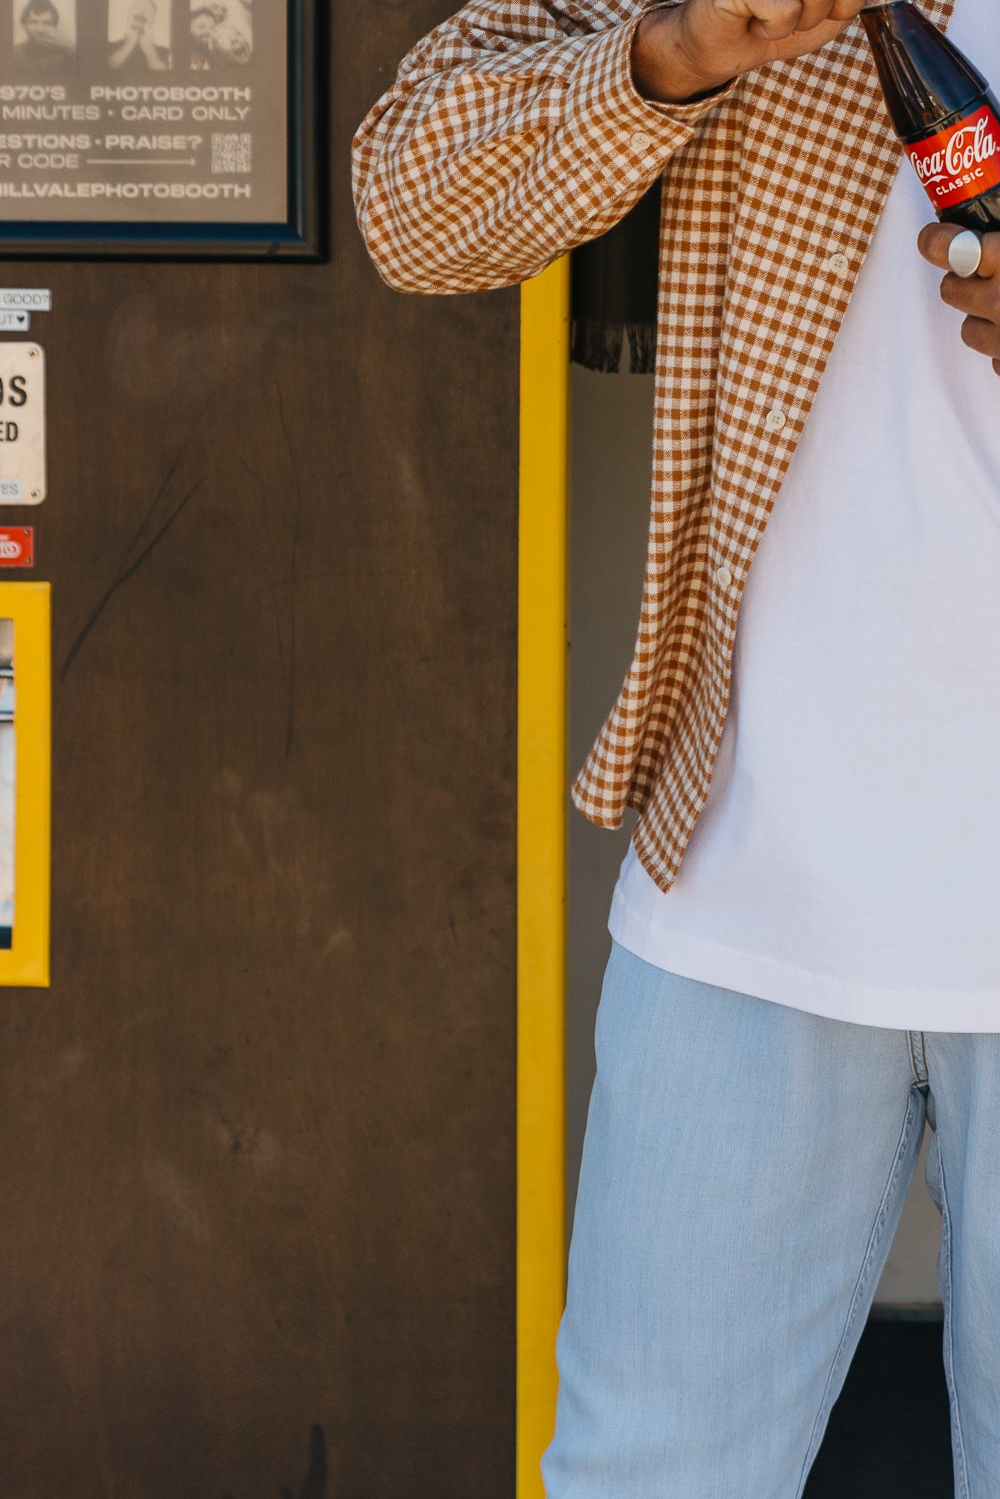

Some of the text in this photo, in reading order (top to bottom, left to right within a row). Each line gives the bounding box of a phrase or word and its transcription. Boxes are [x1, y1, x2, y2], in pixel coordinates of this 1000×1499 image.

[90, 86, 250, 101] PHOTOBOOTH
[2, 105, 250, 120] MINUTES CARD ONLY
[105, 134, 203, 149] PRAISE?
[910, 115, 997, 187] Coca-Cola
[17, 153, 79, 168] CODE
[935, 167, 985, 197] CLASSIC
[0, 183, 250, 199] ILLVALEPHOTOBOOTH
